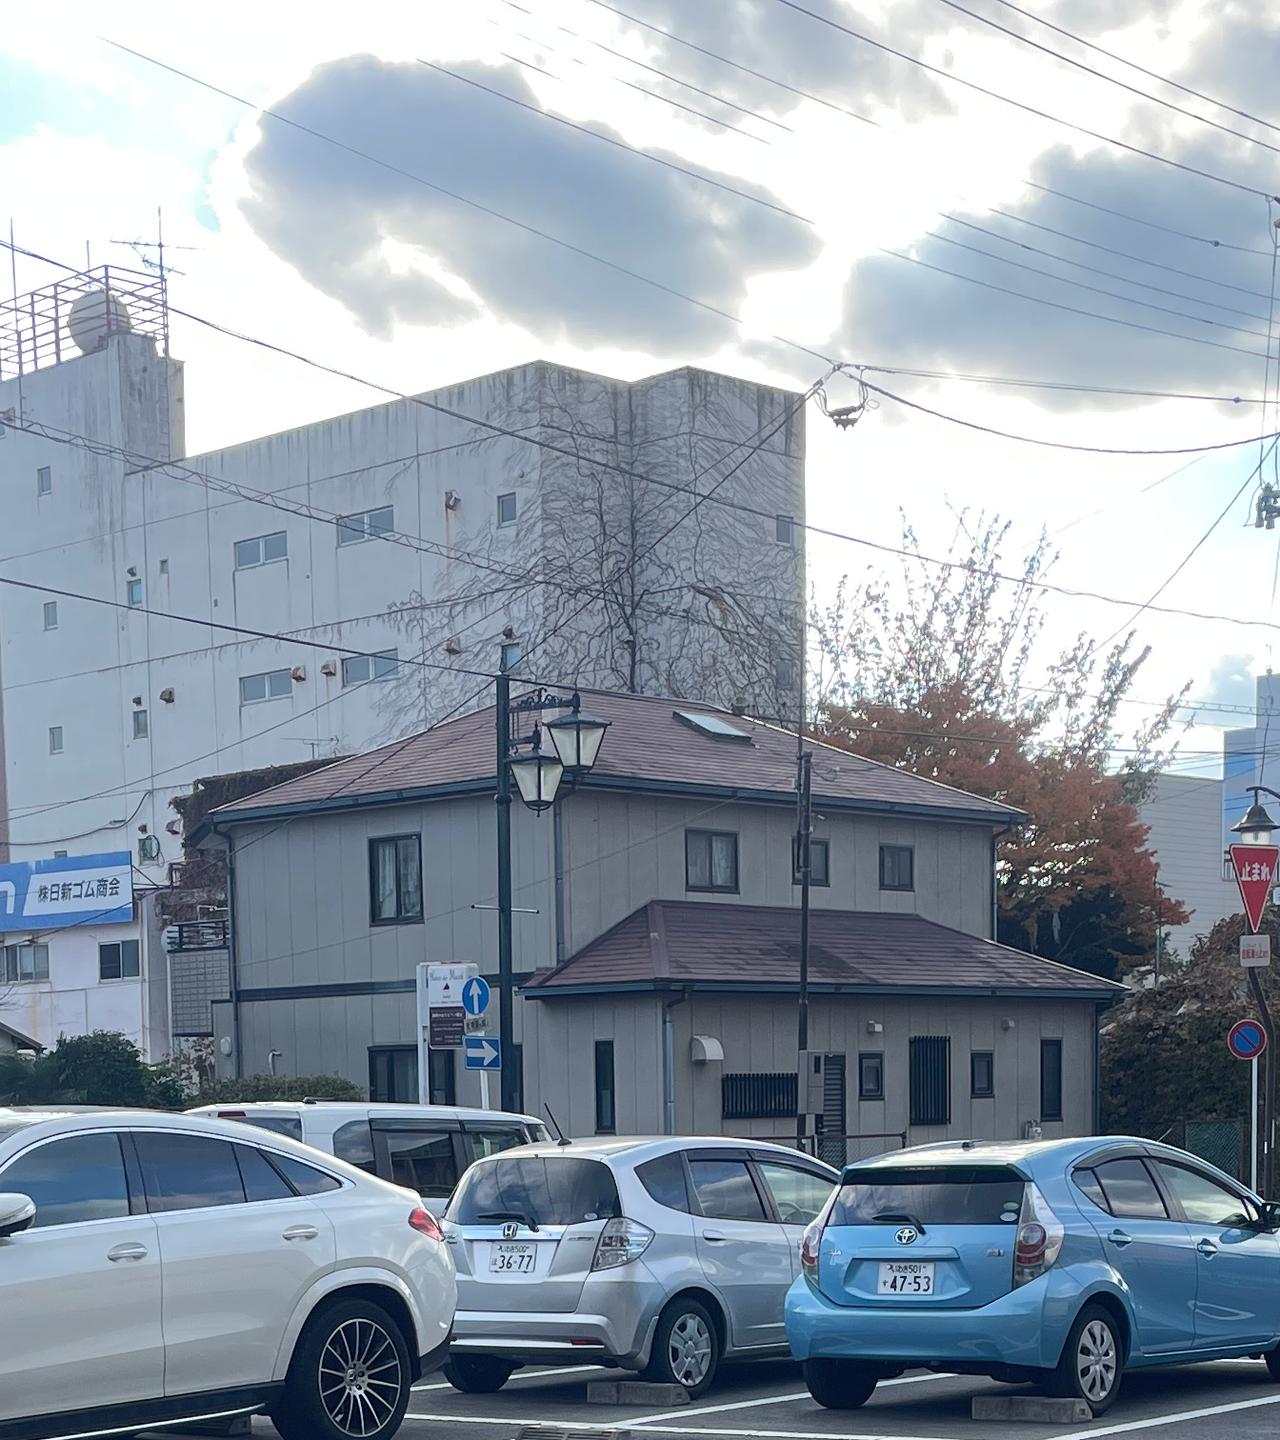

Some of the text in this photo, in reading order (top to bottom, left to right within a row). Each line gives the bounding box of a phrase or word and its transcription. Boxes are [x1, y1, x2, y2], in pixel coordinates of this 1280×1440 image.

[1241, 862, 1270, 881] 止まれ
[499, 1254, 533, 1270] 36-77
[890, 1275, 932, 1292] 47-53
